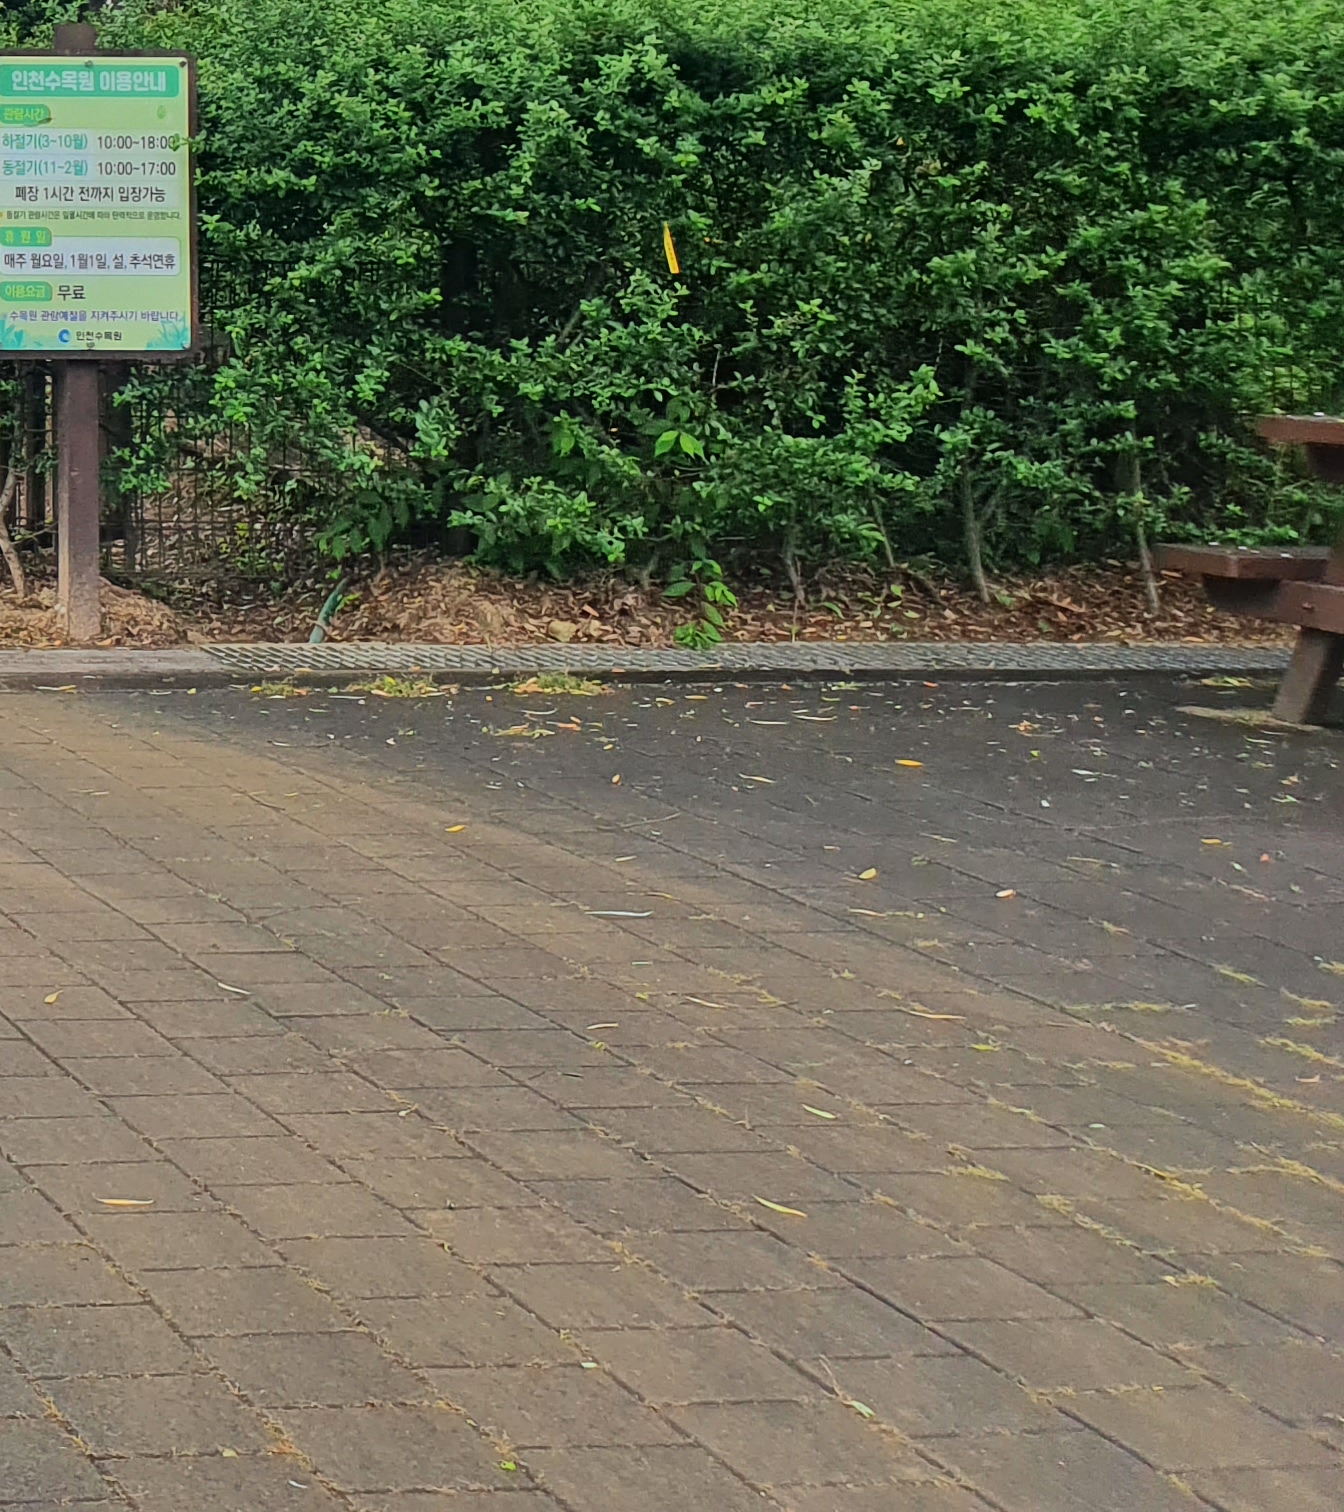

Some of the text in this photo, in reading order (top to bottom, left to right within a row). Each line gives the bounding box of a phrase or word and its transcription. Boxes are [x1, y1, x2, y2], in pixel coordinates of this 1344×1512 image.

[12, 70, 166, 92] 인천수목원 이용안내
[4, 108, 44, 120] 관람시간
[2, 134, 88, 150] 하절기(3~10월)
[2, 160, 176, 176] 동절기(11~2월) 10:00~17:00
[15, 186, 166, 202] 폐장 1시간 전까지 입장가능
[4, 253, 176, 269] 매주 월요일, 1월1일, 설, 추석연휴
[5, 285, 46, 298] 이용요금
[57, 285, 86, 300] 무료
[9, 310, 38, 321] 수목원
[40, 311, 87, 321] 관람예절을
[91, 311, 137, 321] 지켜주시기
[76, 331, 122, 341] 인천수목원
